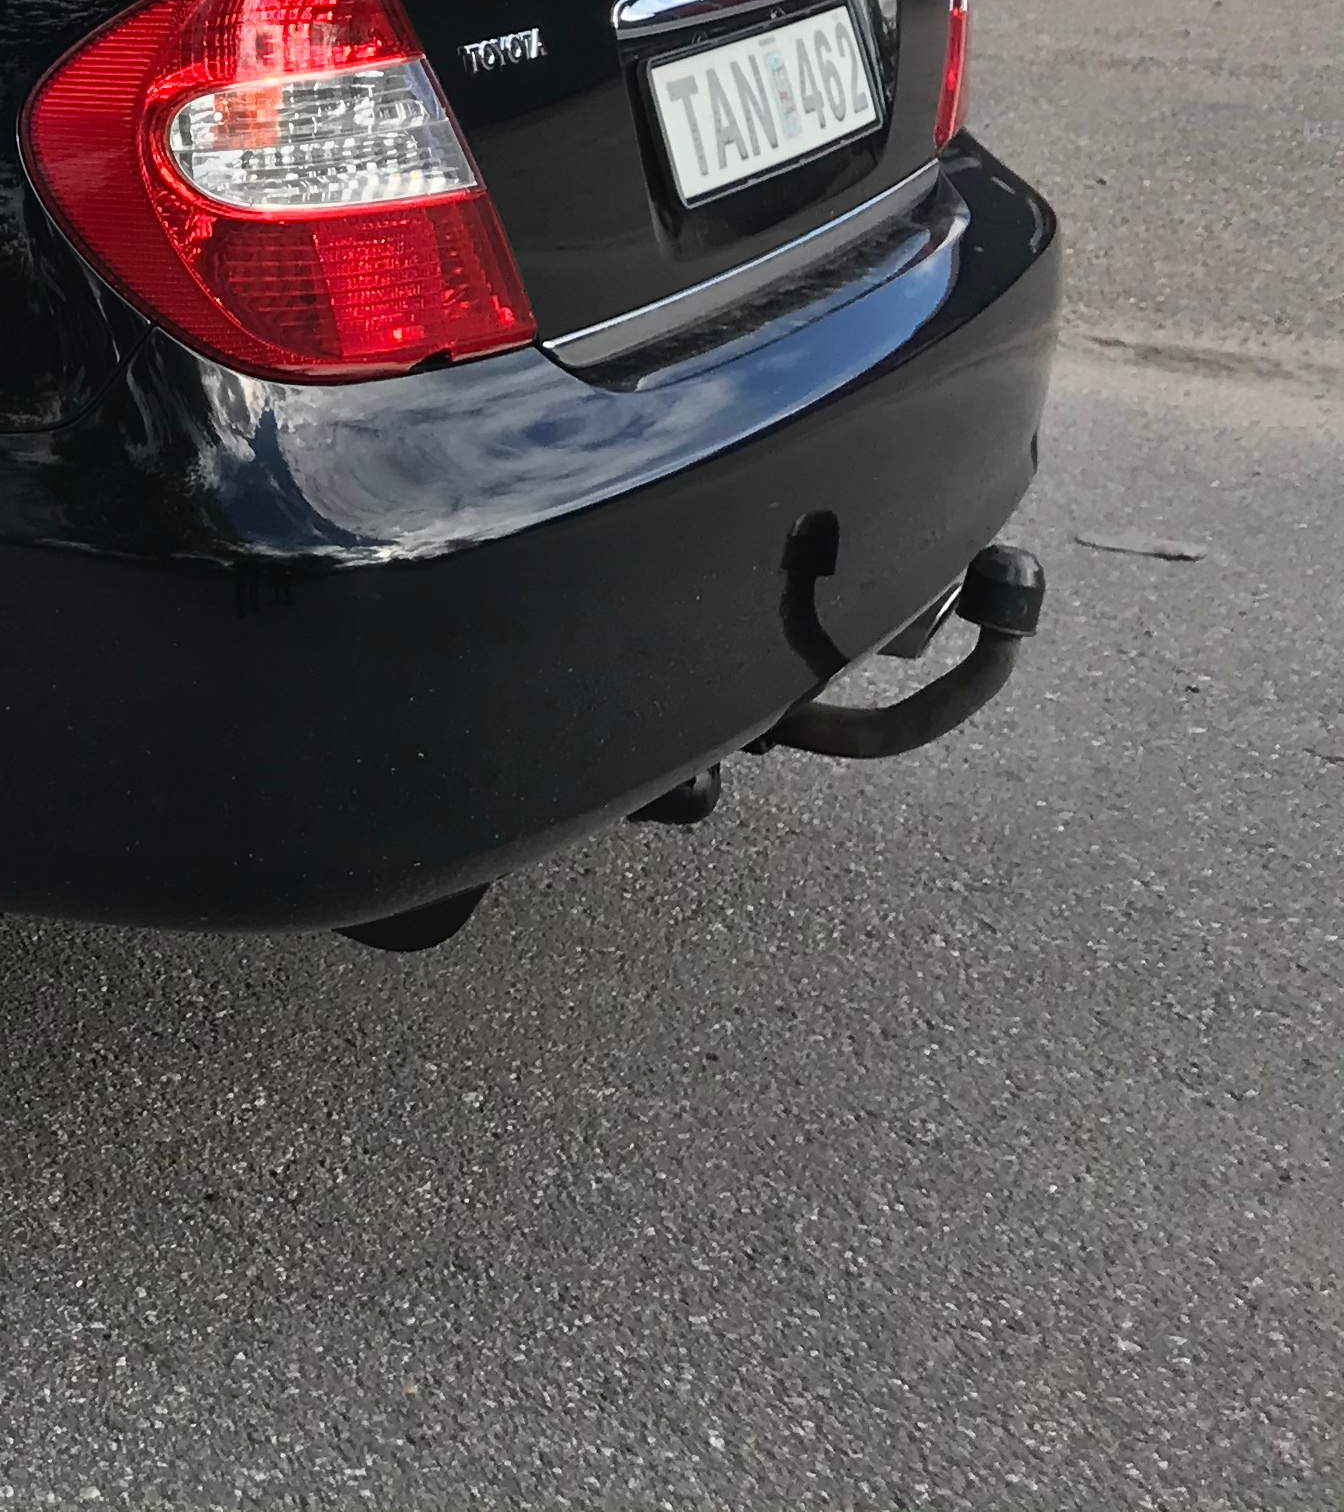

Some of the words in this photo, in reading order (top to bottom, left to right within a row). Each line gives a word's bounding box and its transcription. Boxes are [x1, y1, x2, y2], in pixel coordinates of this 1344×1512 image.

[460, 27, 548, 73] TOYOTA
[665, 53, 779, 177] TAN
[794, 21, 869, 129] 462
